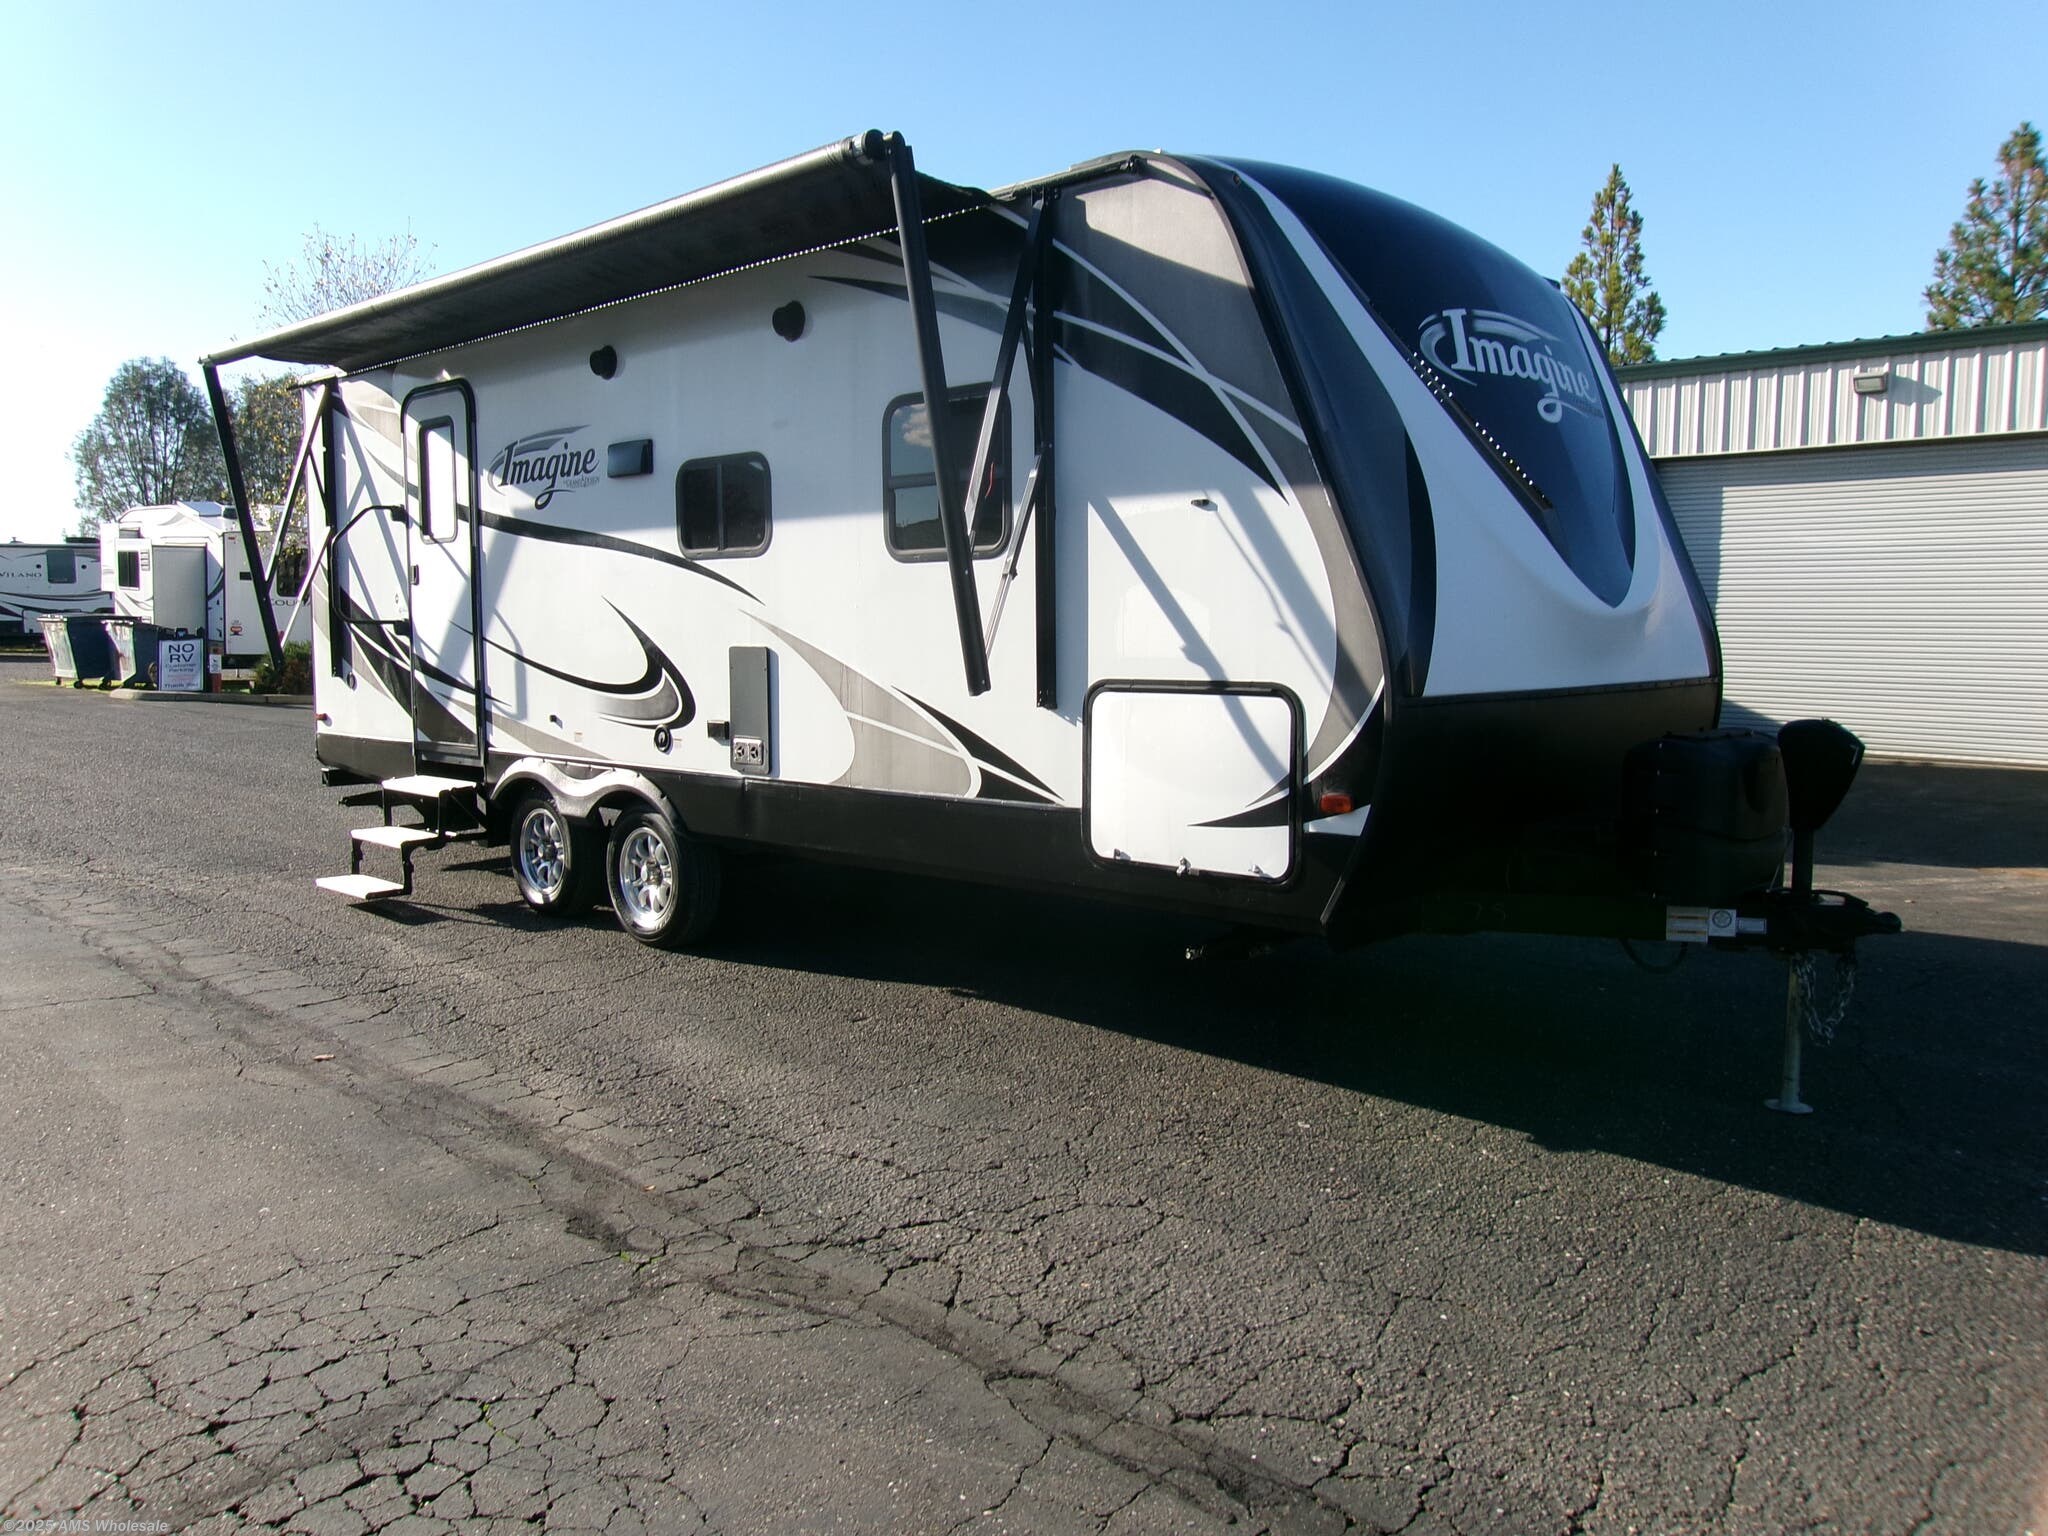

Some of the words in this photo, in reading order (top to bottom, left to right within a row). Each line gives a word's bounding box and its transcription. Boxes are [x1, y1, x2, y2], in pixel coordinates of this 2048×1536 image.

[1442, 308, 1598, 423] Imagine
[498, 440, 599, 510] Imagine
[169, 643, 195, 653] NO
[169, 653, 194, 663] RV
